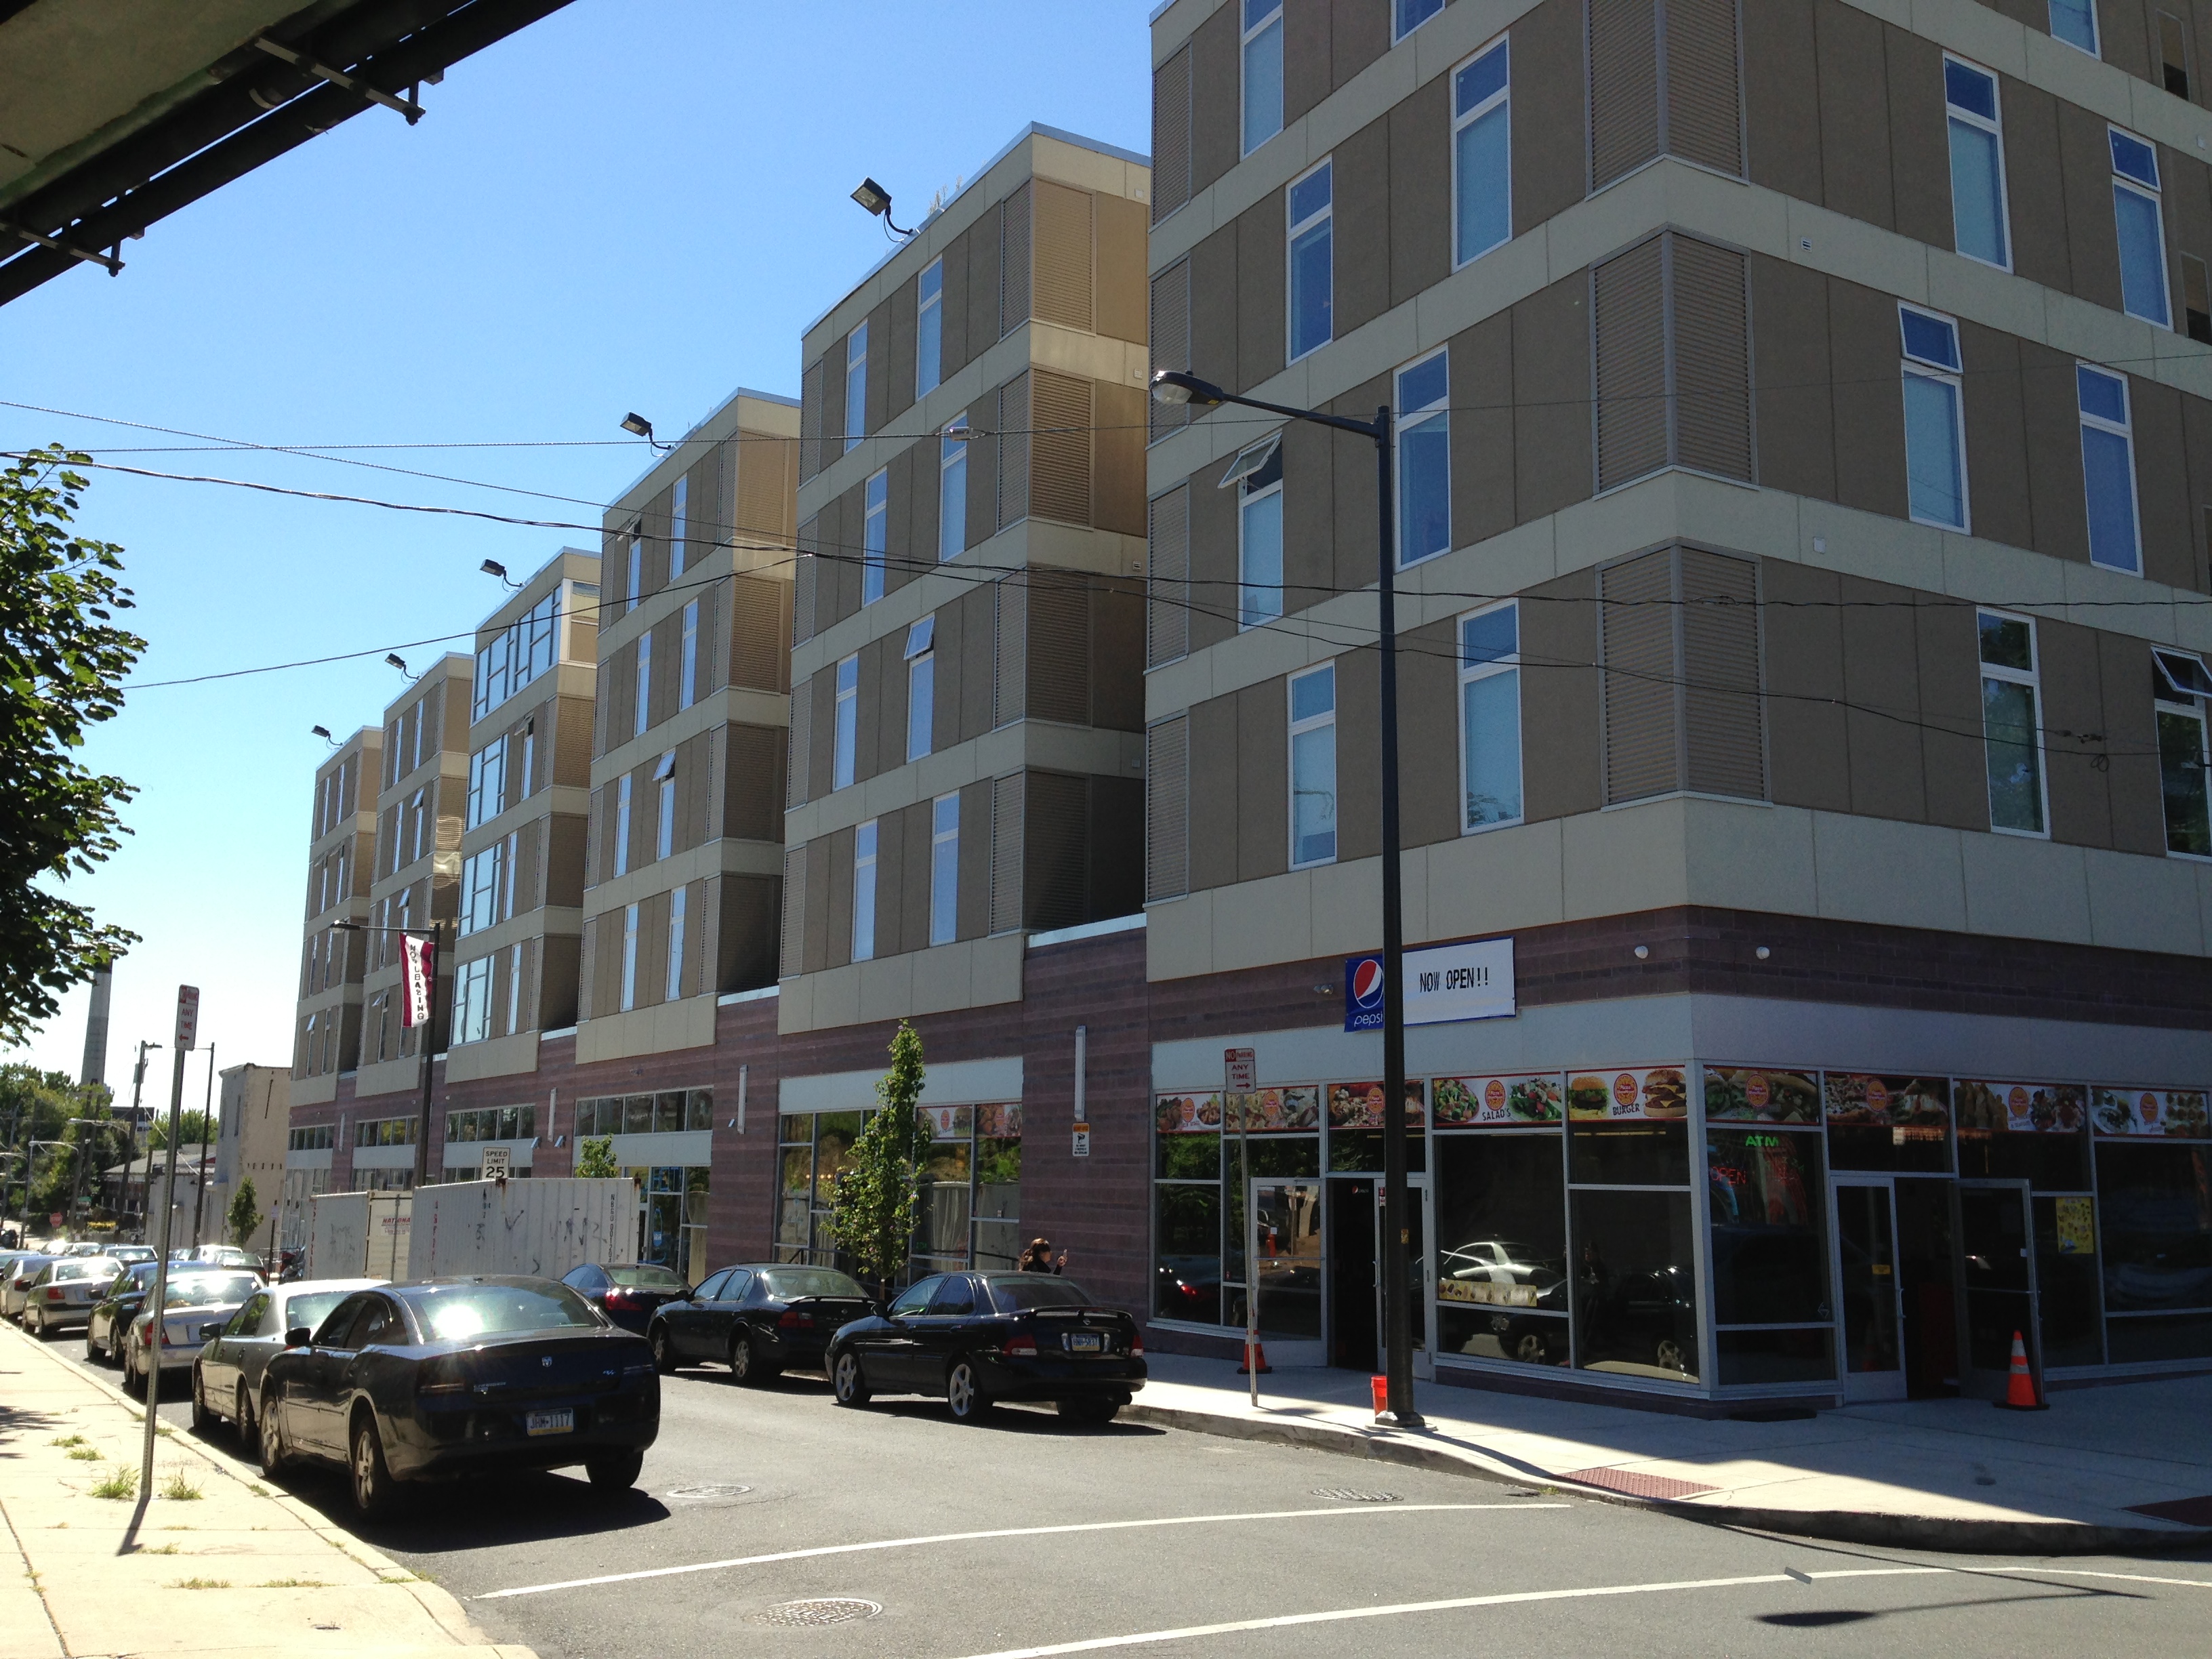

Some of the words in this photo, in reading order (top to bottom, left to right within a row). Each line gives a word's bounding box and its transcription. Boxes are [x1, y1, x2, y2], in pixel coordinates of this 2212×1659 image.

[1419, 970, 1440, 993] NOW
[1446, 966, 1488, 990] OPEN!!
[181, 1008, 194, 1017] ANY
[1354, 1010, 1383, 1027] pepsi
[181, 1020, 192, 1030] TIME
[1226, 1050, 1235, 1061] NO
[1482, 1107, 1511, 1121] SALAD'S
[1612, 1103, 1640, 1115] BURGER
[1745, 1134, 1780, 1147] ATM
[485, 1166, 505, 1178] 25
[1710, 1166, 1746, 1186] OPEN
